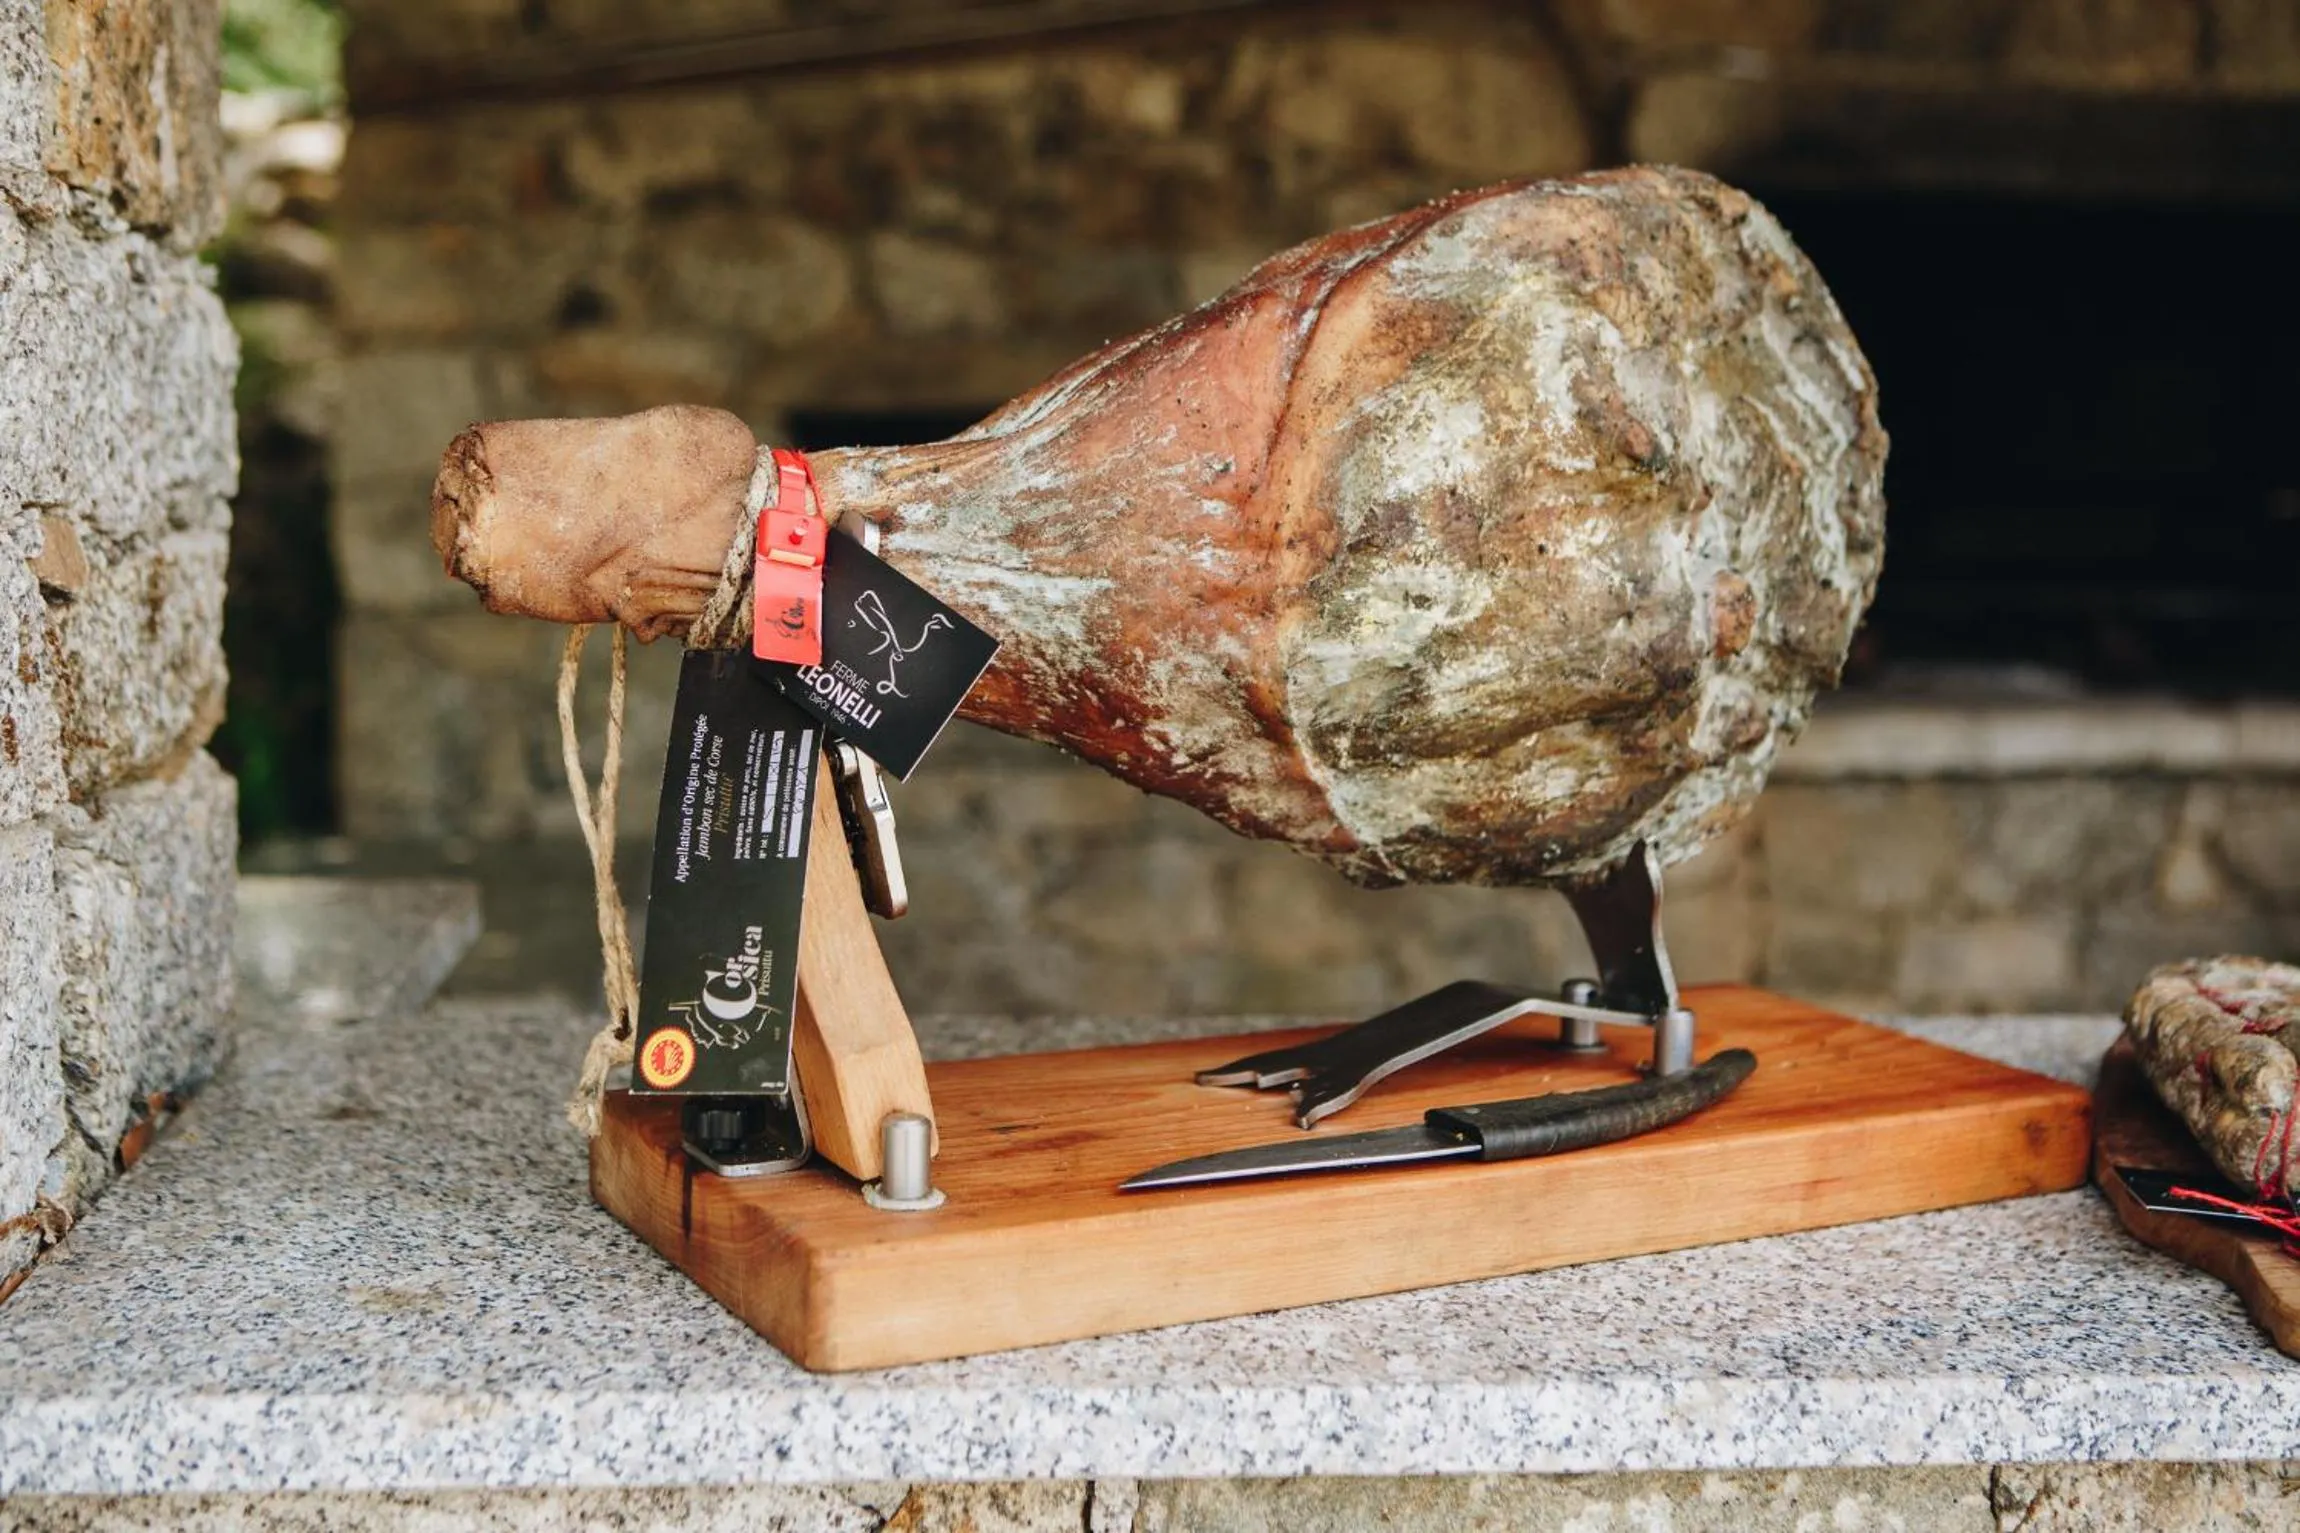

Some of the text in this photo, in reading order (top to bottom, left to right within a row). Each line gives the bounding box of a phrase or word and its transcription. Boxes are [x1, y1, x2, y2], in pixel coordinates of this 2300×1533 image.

[797, 661, 882, 729] LEONELLI
[830, 660, 870, 694] FERME
[675, 714, 708, 882] Appellation d'Origine Protégée
[695, 736, 723, 860] Jambon sec de Corse
